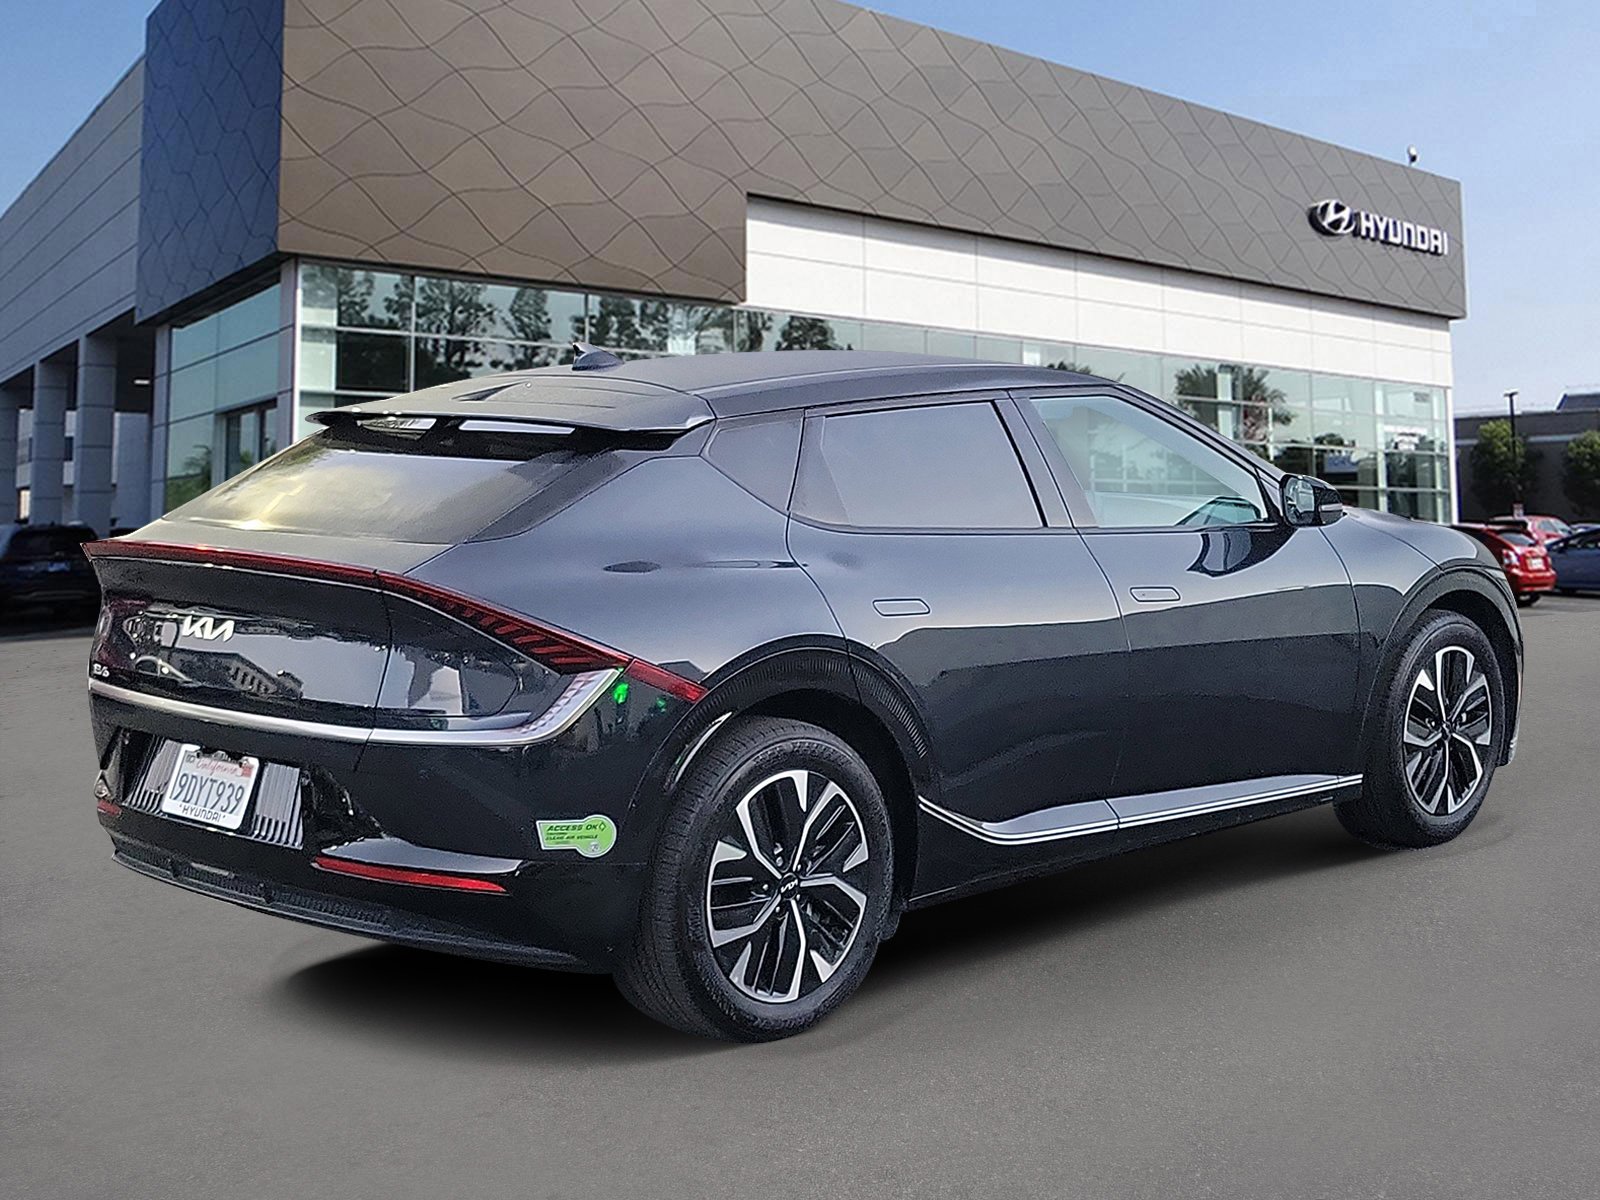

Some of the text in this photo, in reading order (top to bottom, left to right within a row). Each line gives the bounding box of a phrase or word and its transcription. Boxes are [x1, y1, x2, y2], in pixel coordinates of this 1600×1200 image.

[1360, 210, 1449, 256] HYUNDAI
[182, 615, 235, 642] KIA
[173, 772, 245, 815] 9DYT939
[182, 804, 222, 823] HYUNDAI
